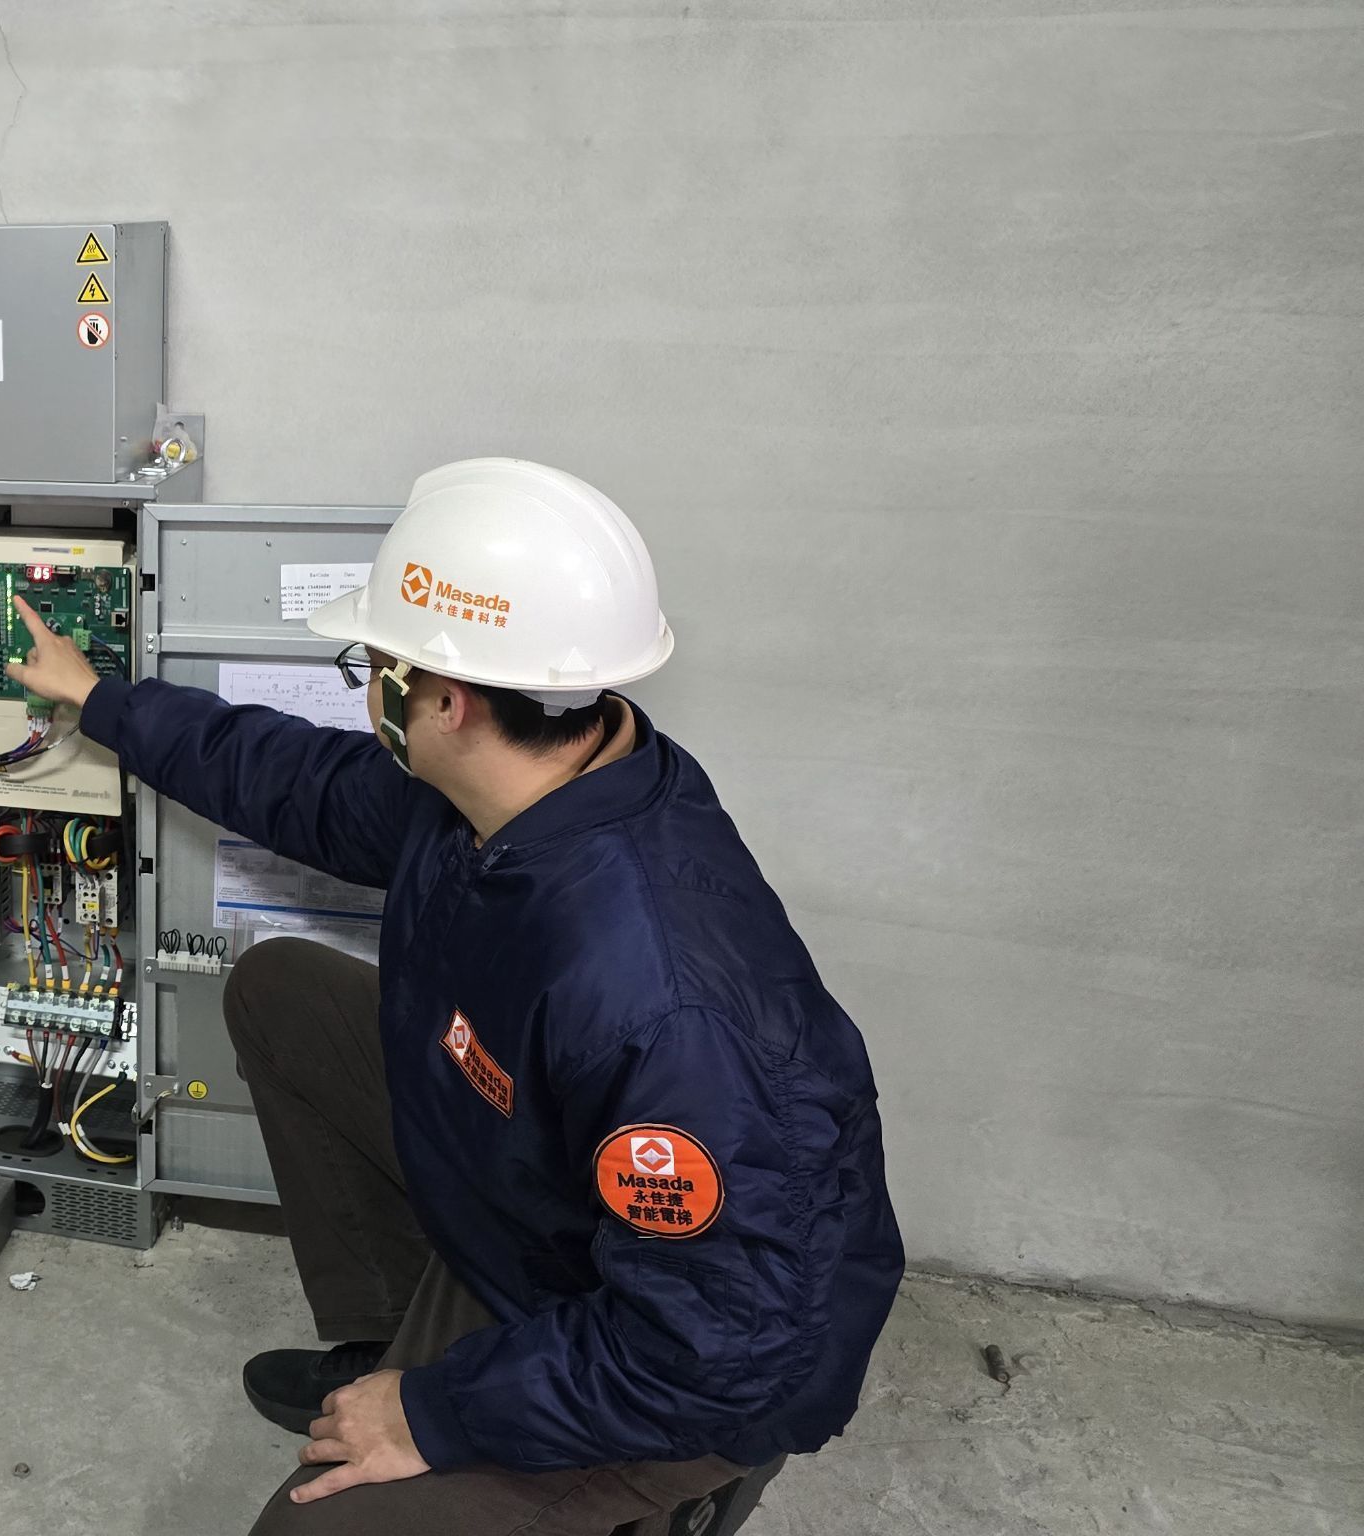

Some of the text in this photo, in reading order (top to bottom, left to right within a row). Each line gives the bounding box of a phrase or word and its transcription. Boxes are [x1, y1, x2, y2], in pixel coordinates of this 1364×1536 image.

[436, 580, 510, 613] Masada
[465, 1042, 508, 1095] Masada
[617, 1172, 694, 1192] Masada
[633, 1190, 684, 1207] 永佳捷
[626, 1204, 693, 1226] 智能電梯
